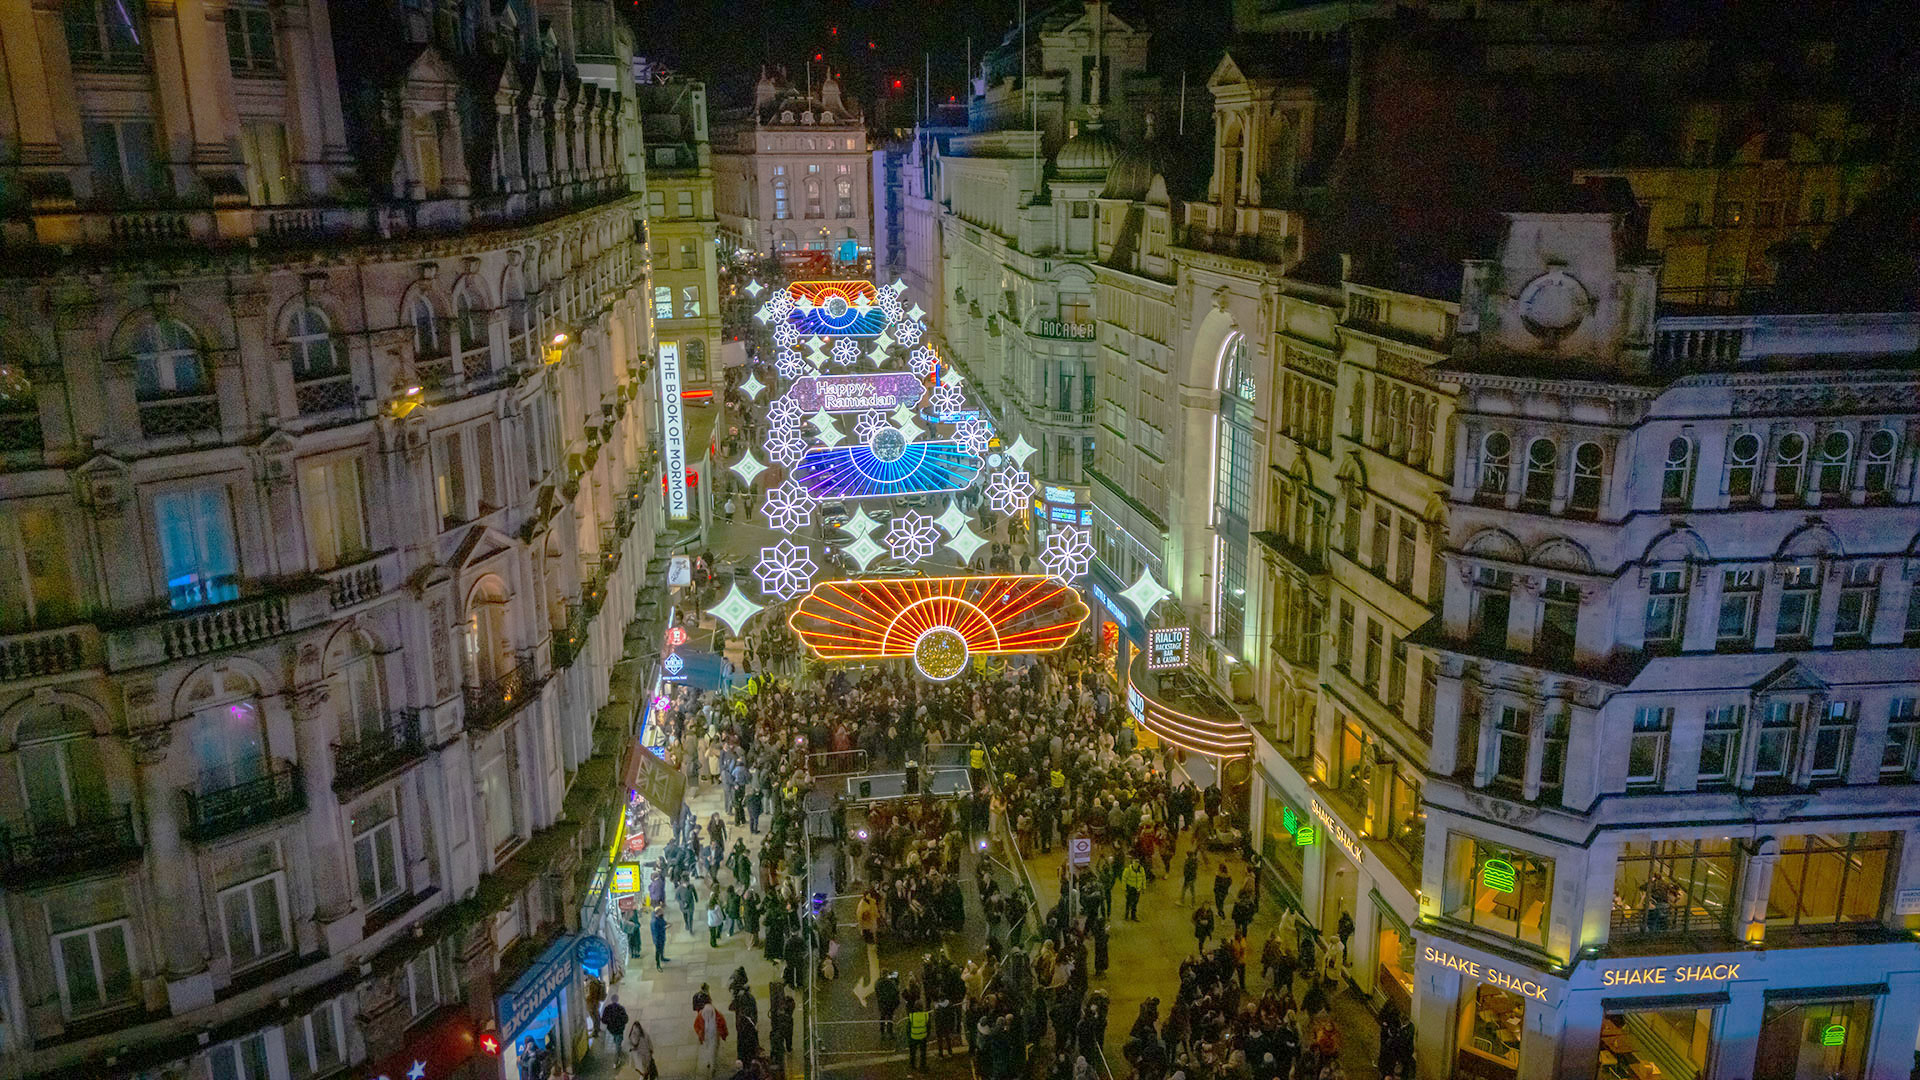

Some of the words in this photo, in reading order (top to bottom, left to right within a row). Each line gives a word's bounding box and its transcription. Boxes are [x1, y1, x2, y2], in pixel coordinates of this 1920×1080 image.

[664, 353, 676, 380] THE
[816, 381, 866, 396] Happy
[824, 393, 897, 408] Ramadan
[666, 384, 679, 424] BOOK
[668, 426, 680, 446] OF
[670, 449, 684, 510] MORMON
[1155, 632, 1183, 643] RIALTO
[1311, 799, 1336, 833] SHAKE
[1336, 826, 1363, 863] SHACK
[1424, 947, 1480, 978] SHAKE
[1487, 968, 1548, 1001] SHACK
[1603, 968, 1667, 986] SHAKE
[1675, 964, 1740, 982] SHACK
[503, 959, 572, 1041] EXCHANGE
